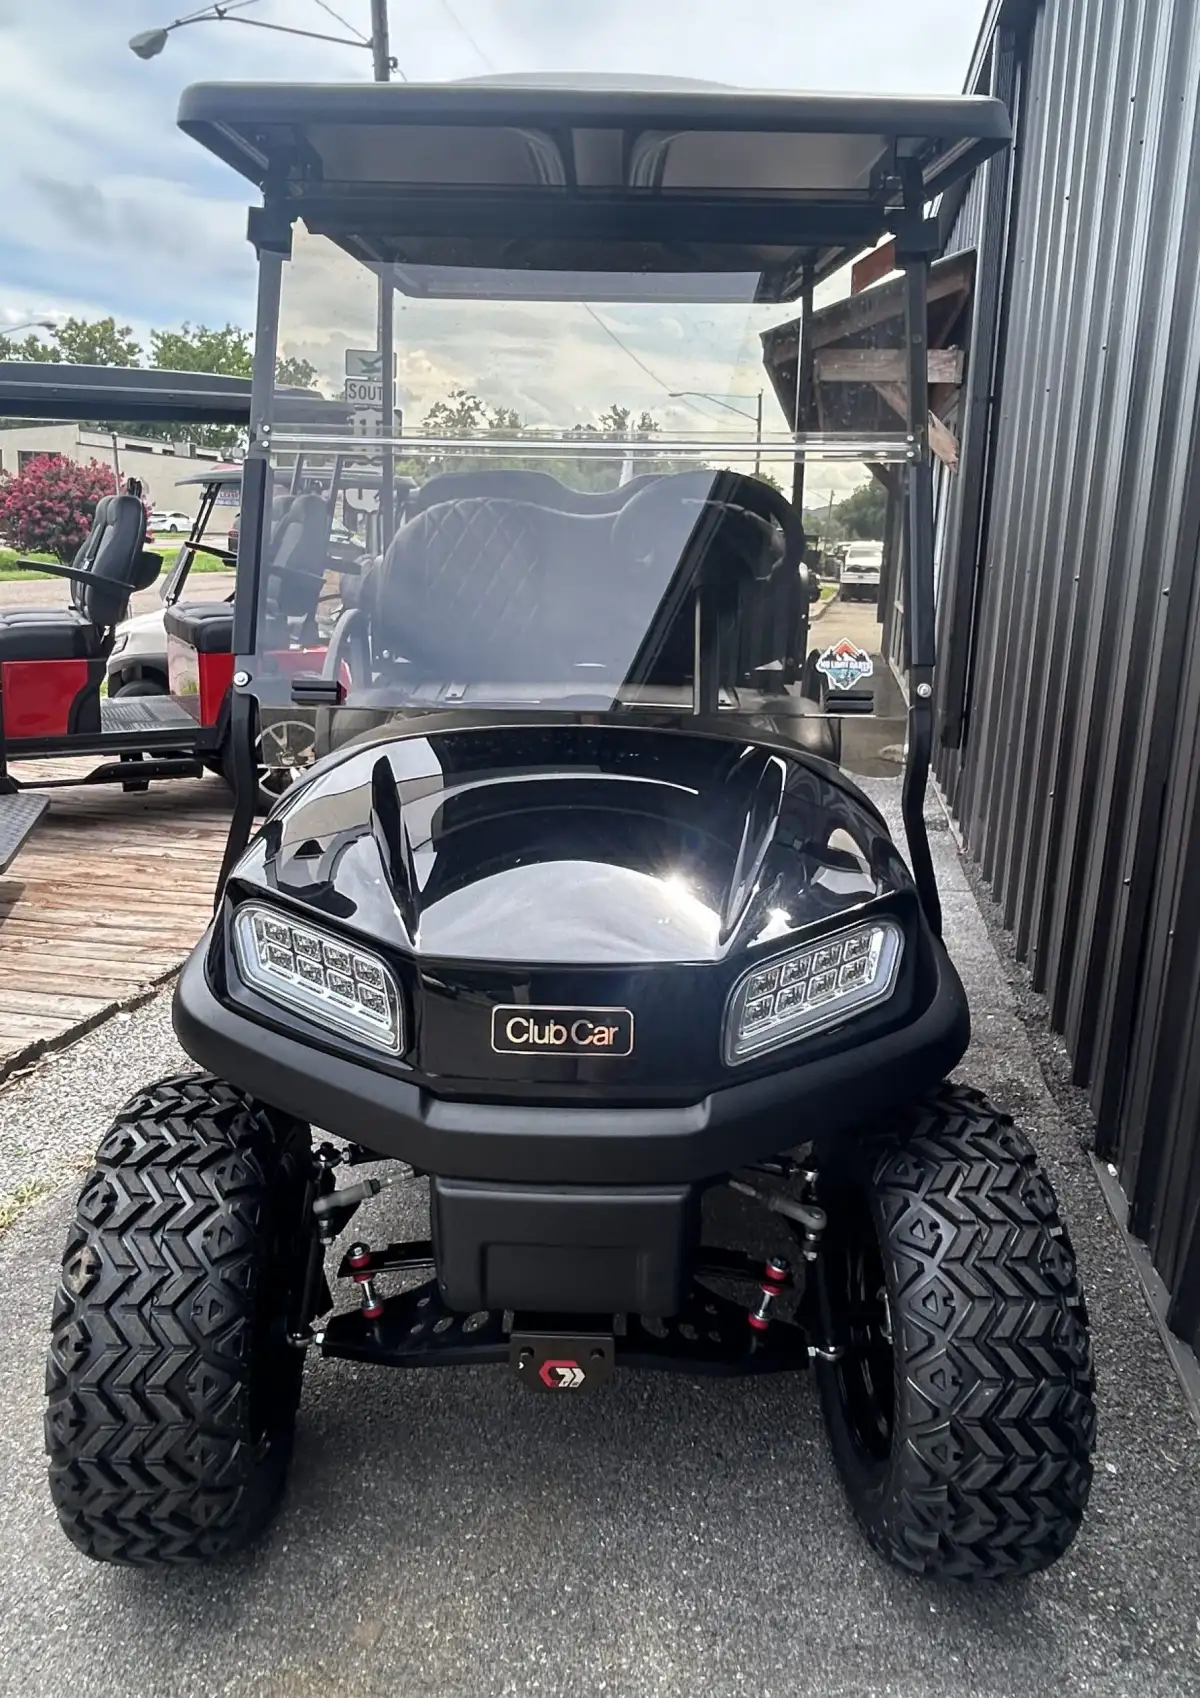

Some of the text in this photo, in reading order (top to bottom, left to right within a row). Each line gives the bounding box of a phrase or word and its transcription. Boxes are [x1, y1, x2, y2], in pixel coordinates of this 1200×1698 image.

[348, 382, 384, 401] SOUT
[506, 1017, 619, 1046] Club Car
